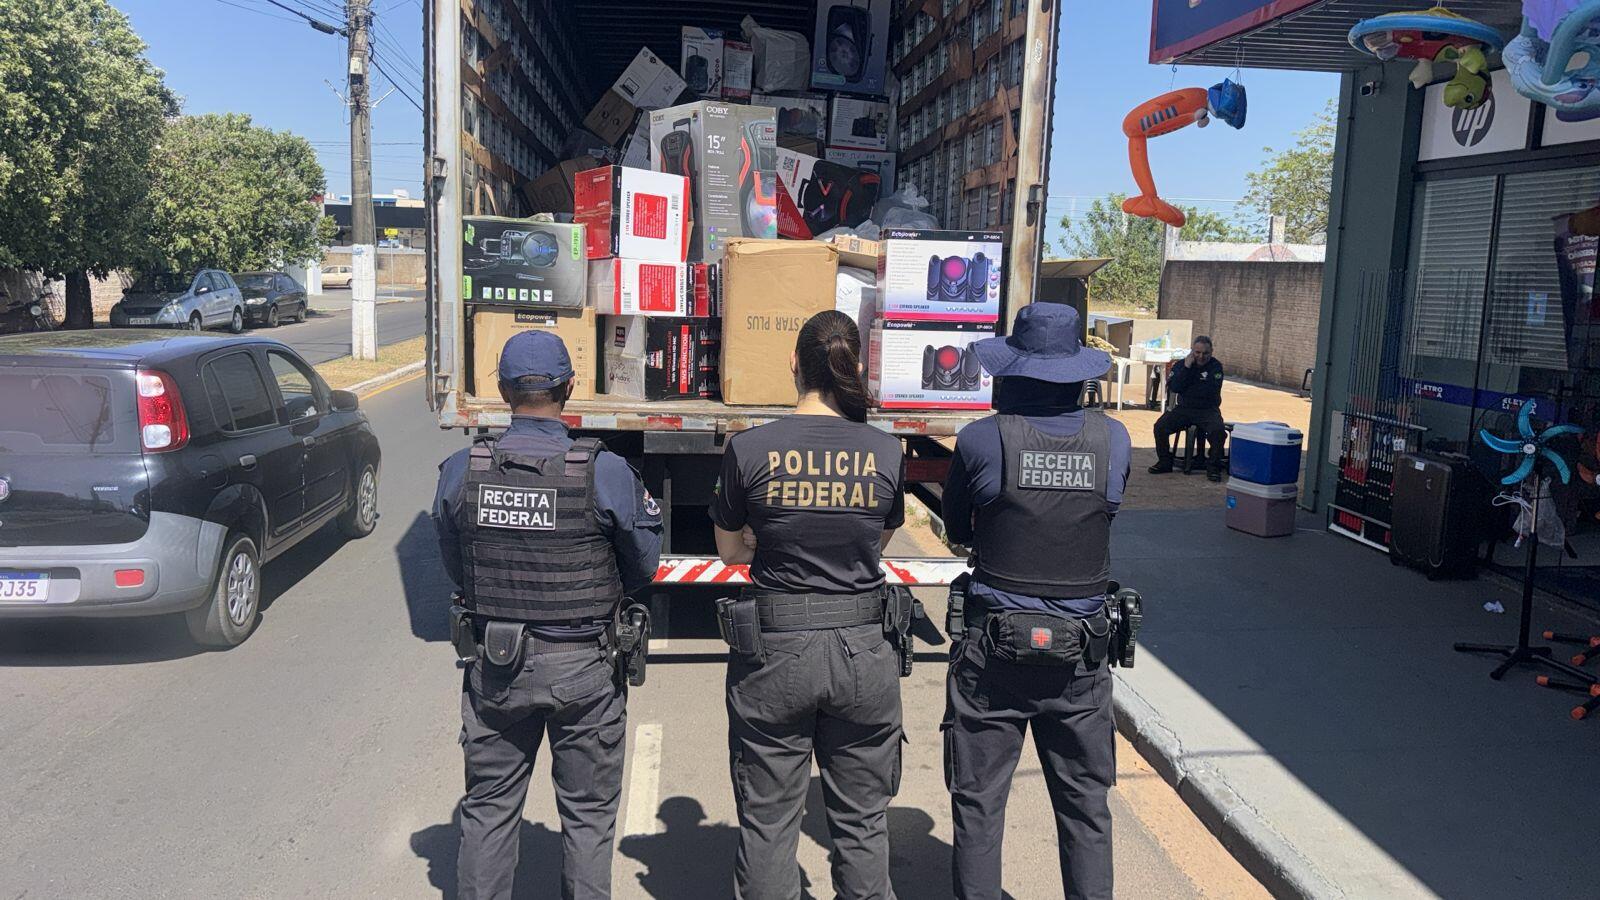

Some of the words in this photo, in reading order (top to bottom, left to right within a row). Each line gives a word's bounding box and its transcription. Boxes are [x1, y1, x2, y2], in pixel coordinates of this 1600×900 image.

[706, 106, 728, 114] COBY
[891, 231, 918, 239] Ecopower
[517, 313, 552, 321] Ecopower
[747, 316, 770, 331] PLUS
[776, 317, 799, 331] STAR
[1502, 397, 1538, 409] ELETO
[1022, 453, 1093, 471] RECEITA
[1021, 469, 1093, 487] FEDERAL
[483, 489, 550, 508] RECEITA
[766, 481, 879, 507] FEDERAL
[480, 508, 553, 527] FEDERAL
[0, 581, 37, 597] J35
